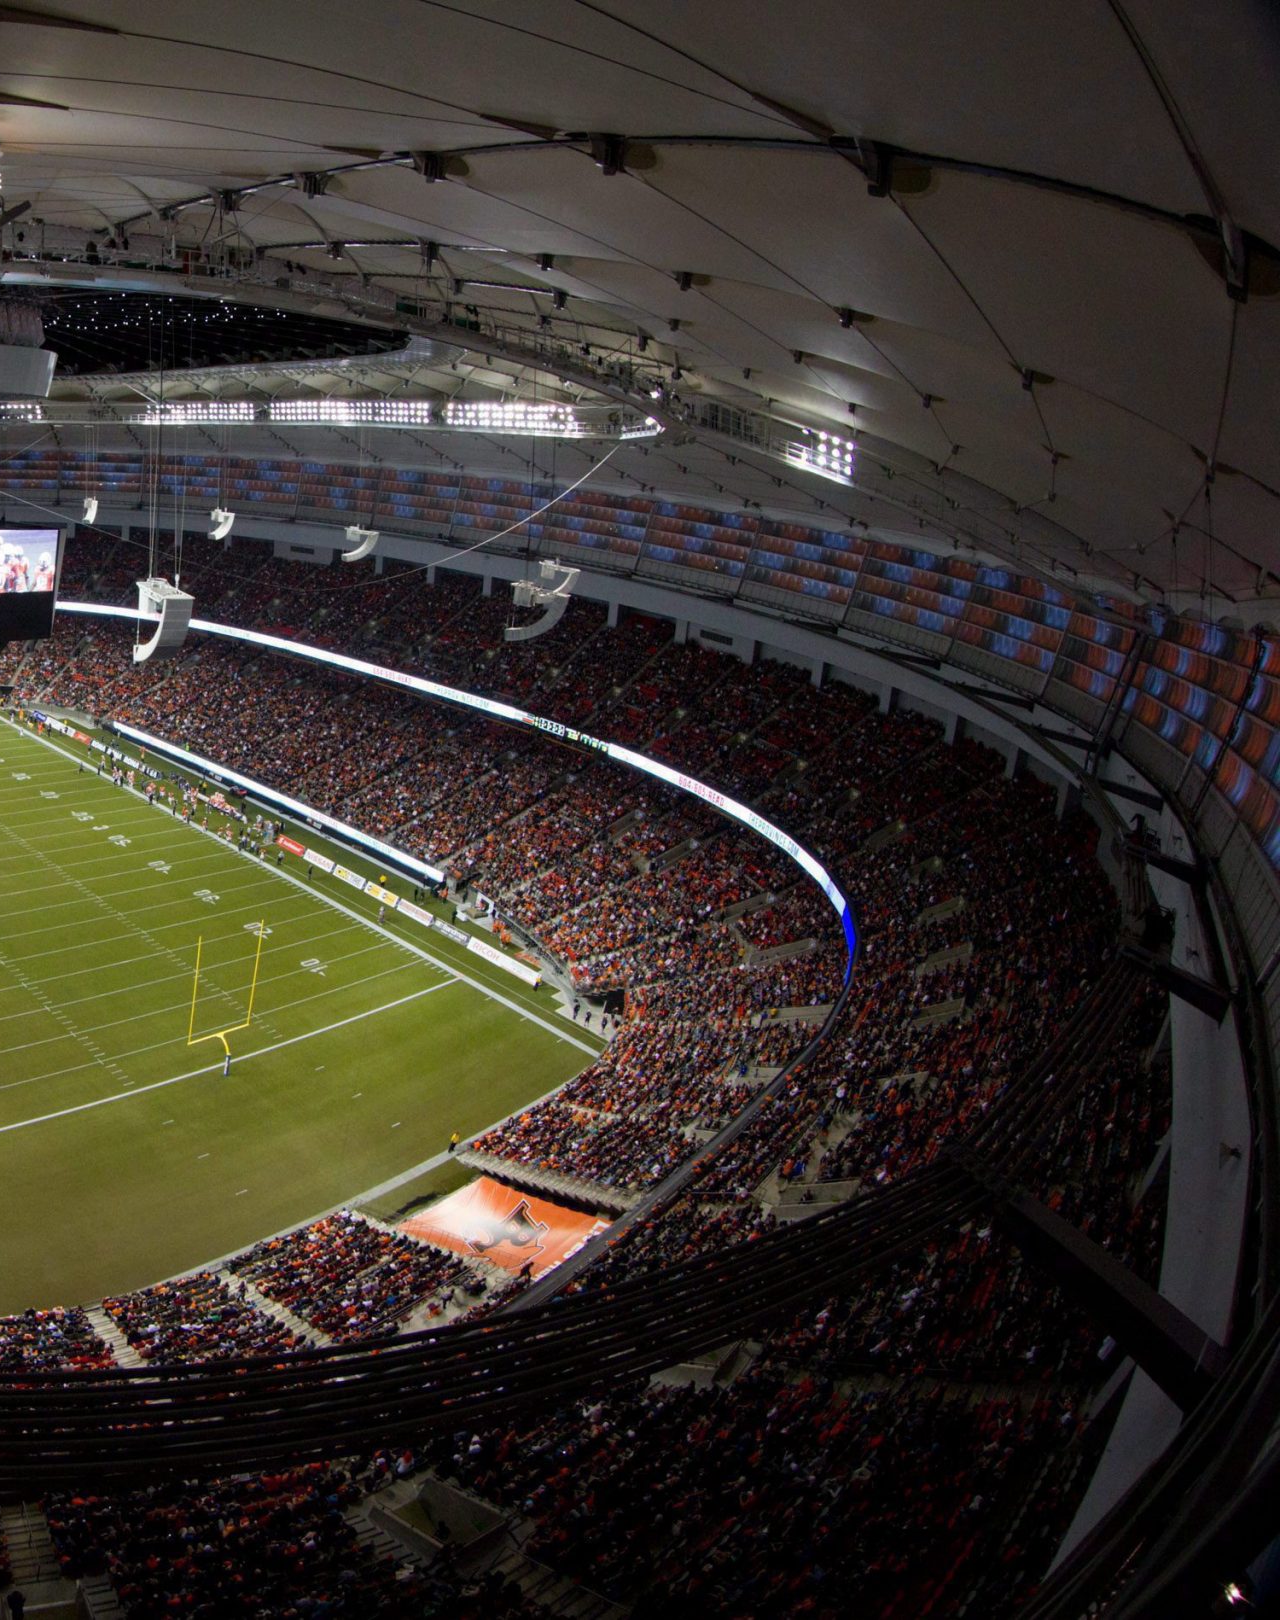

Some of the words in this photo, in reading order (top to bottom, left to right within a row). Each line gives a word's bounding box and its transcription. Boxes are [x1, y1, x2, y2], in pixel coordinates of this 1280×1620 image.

[147, 860, 172, 873] 40
[193, 889, 220, 903] 30
[243, 922, 273, 938] 20
[473, 942, 500, 961] RICOH
[300, 958, 328, 974] 10
